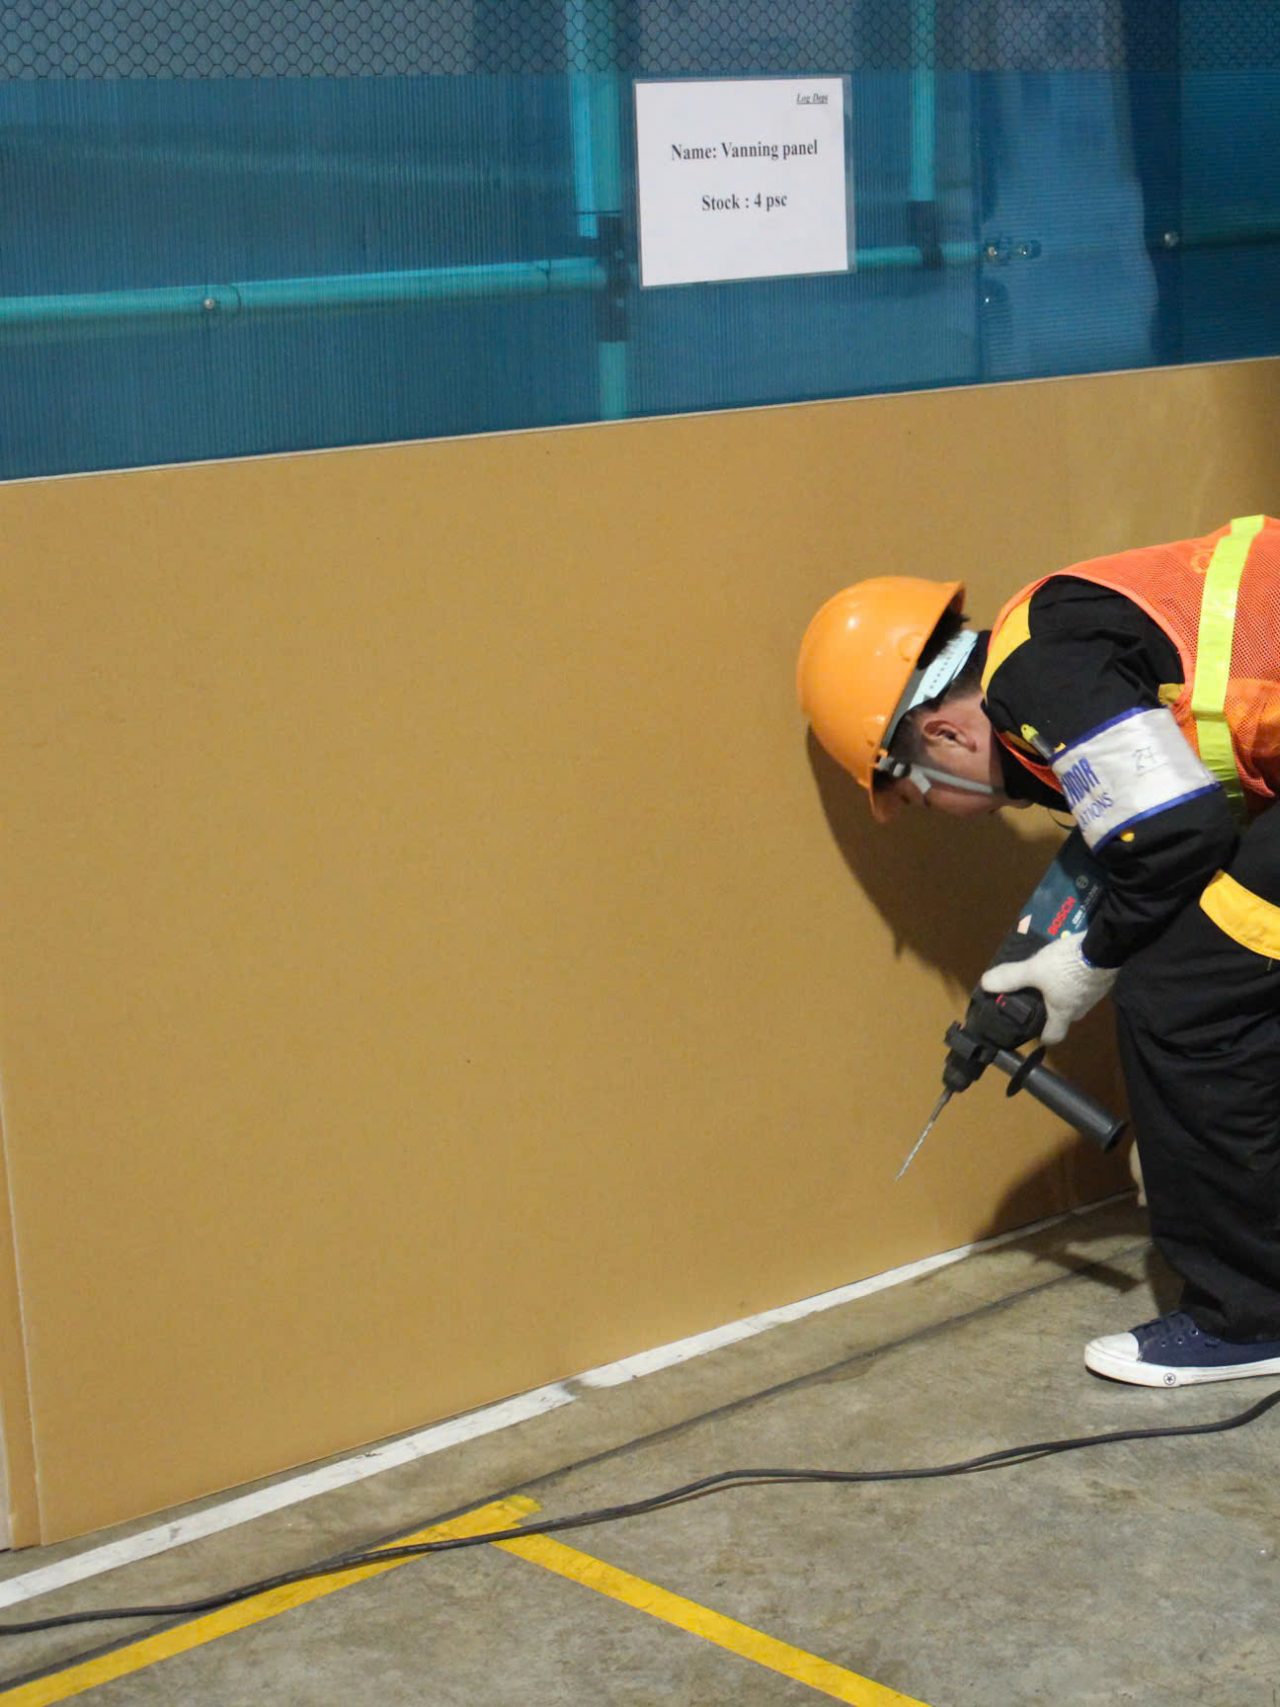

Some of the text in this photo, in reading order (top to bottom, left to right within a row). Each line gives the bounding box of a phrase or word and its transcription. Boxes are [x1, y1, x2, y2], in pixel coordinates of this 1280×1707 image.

[671, 139, 818, 161] Name: Vanning panel
[702, 193, 740, 212] Stock
[754, 192, 762, 208] 4
[765, 195, 788, 212] psc
[1062, 757, 1100, 808] NDOR
[1047, 896, 1076, 936] BOSCH
